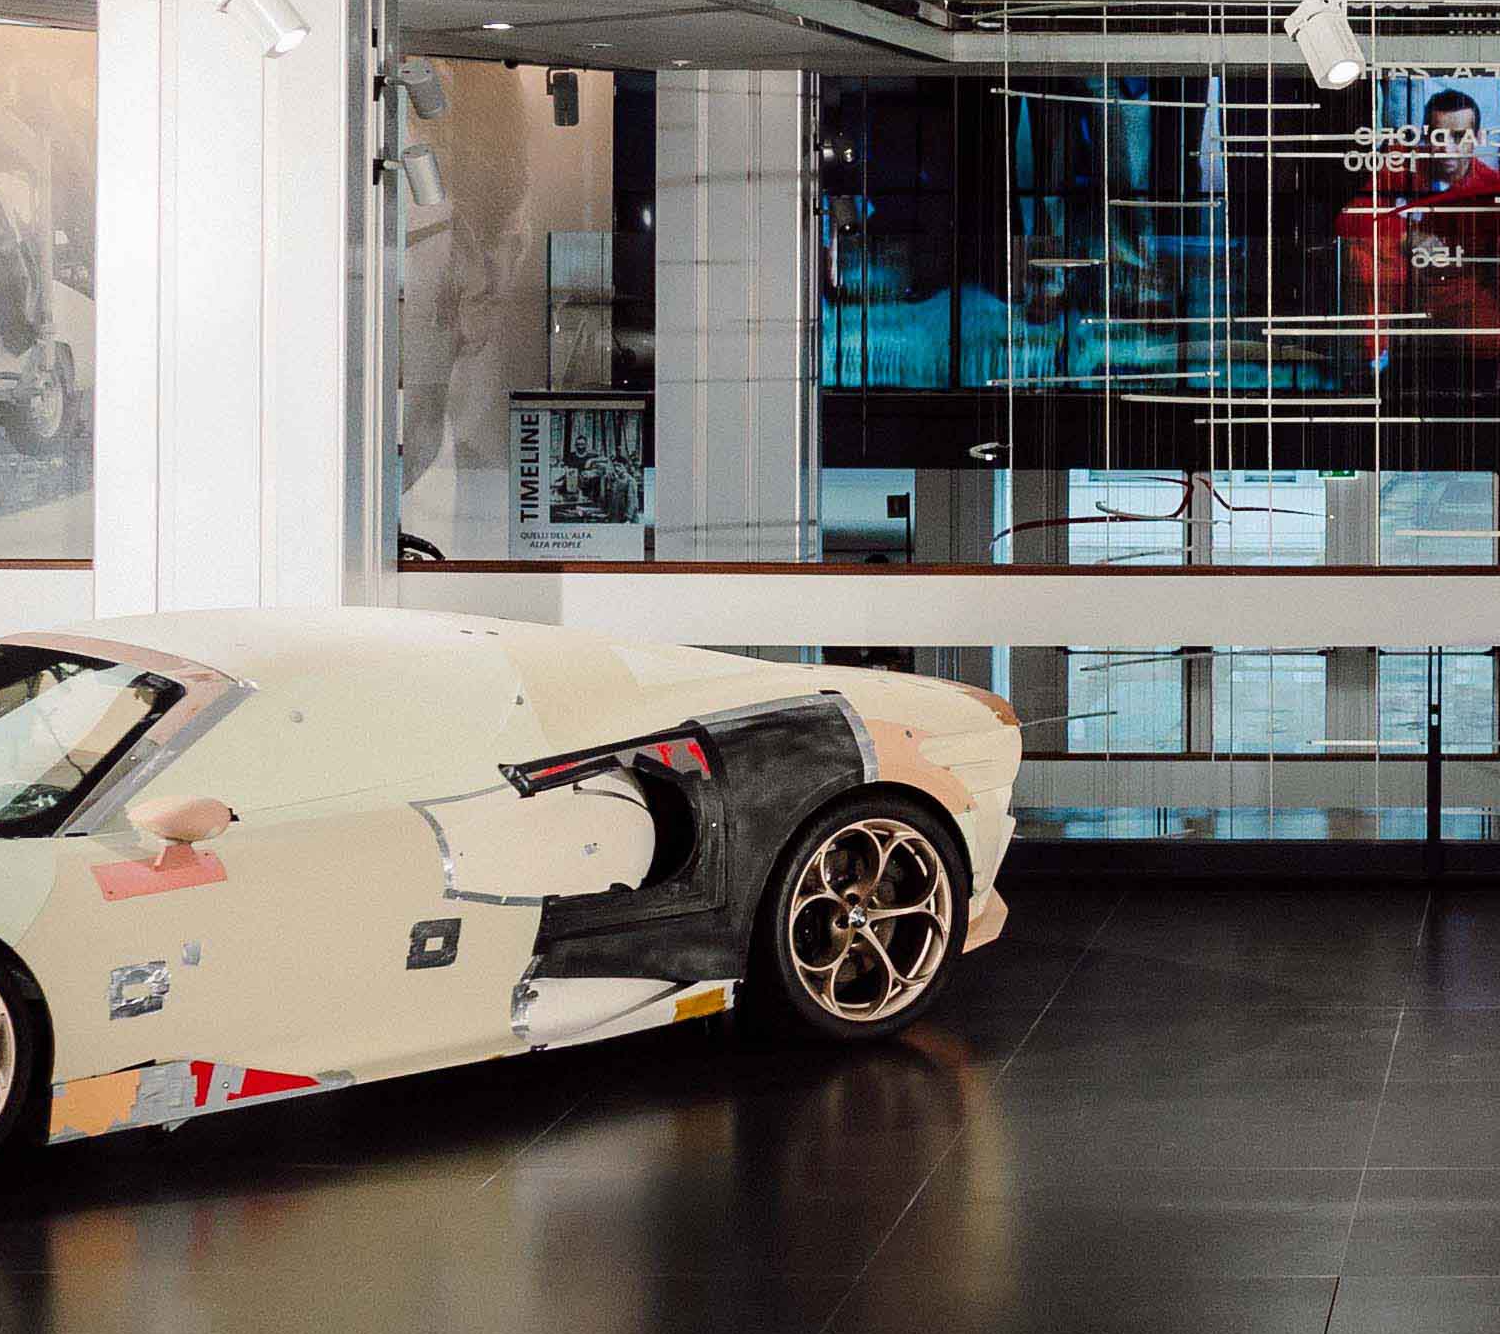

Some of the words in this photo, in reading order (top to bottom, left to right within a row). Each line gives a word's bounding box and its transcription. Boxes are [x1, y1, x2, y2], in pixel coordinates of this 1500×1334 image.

[520, 413, 540, 524] TIMELINE
[530, 540, 550, 548] ALFA
[551, 540, 581, 548] PEOPLE
